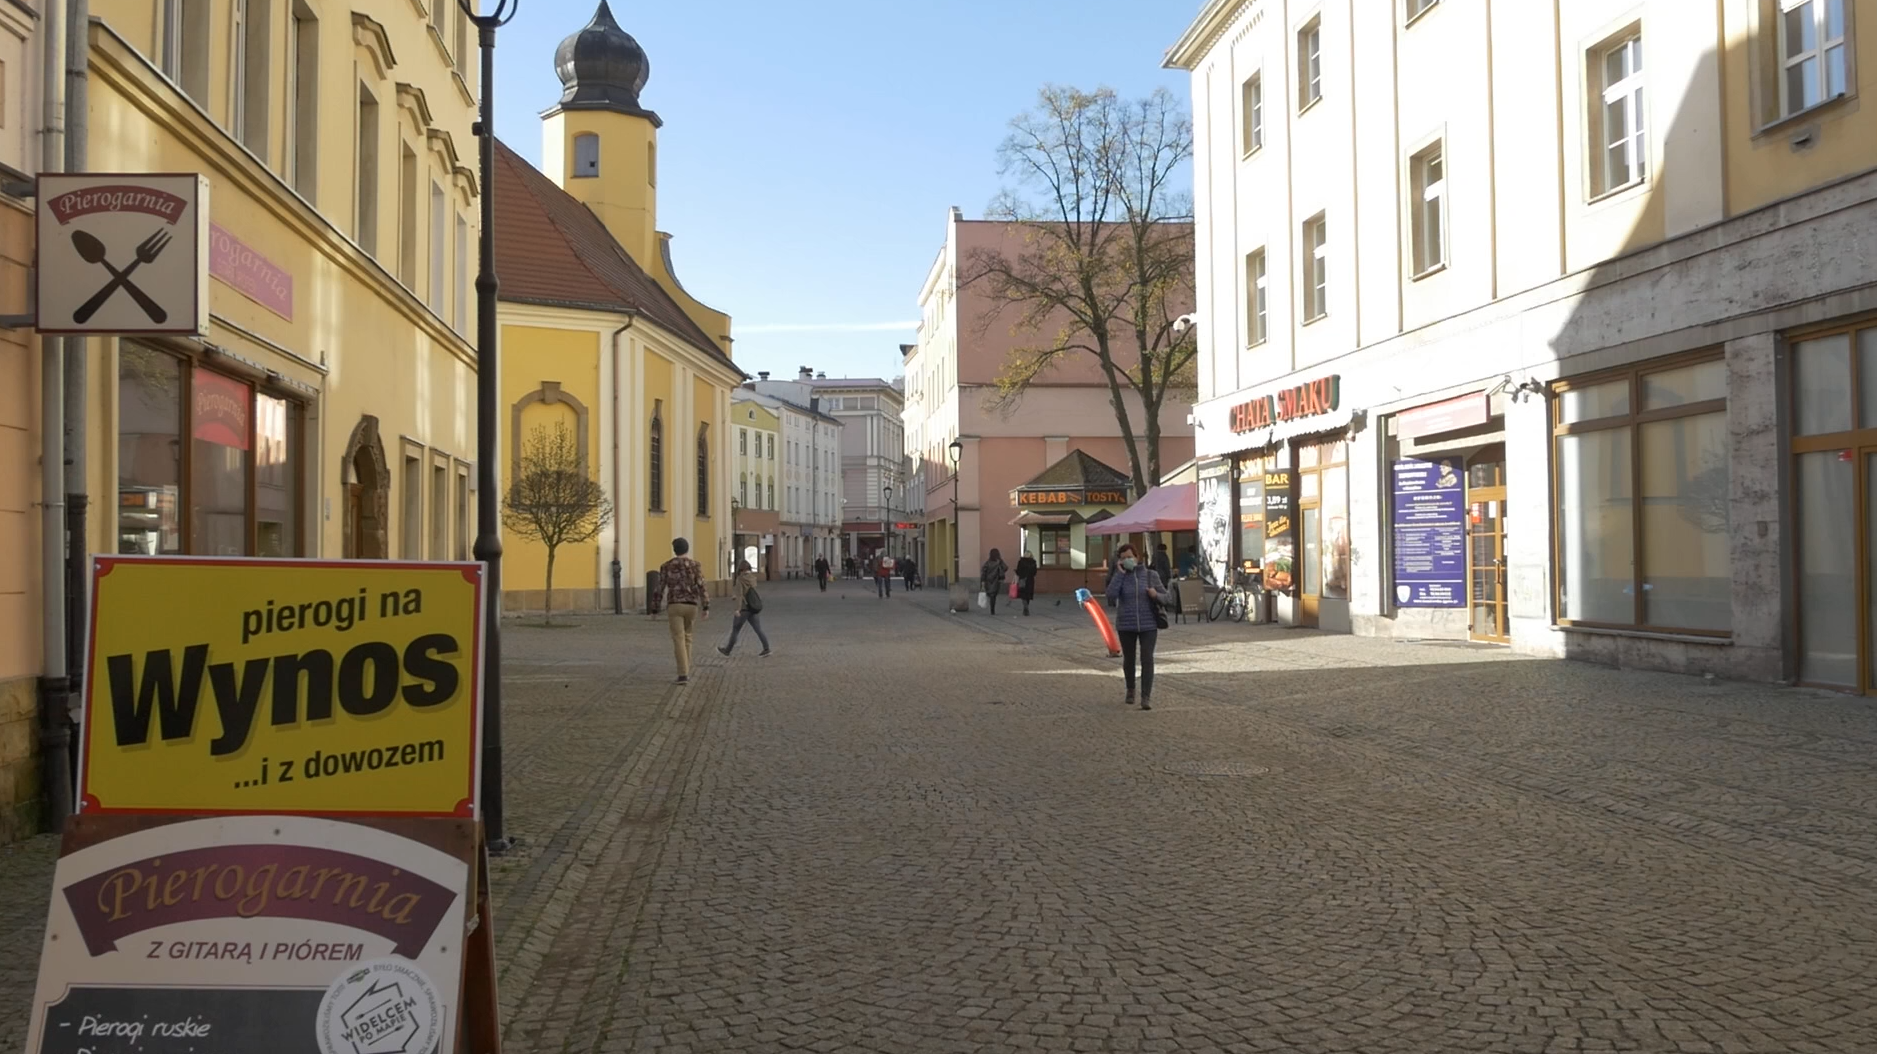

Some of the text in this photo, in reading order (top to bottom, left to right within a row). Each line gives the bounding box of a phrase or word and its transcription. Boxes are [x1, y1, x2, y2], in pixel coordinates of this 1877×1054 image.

[60, 191, 175, 214] Pierogarnia
[210, 230, 287, 300] rogarnia
[1276, 375, 1340, 422] SMAKU
[1265, 474, 1289, 484] BAR
[1020, 492, 1119, 504] KEBAB TOSTY
[242, 588, 422, 644] pierogi na
[107, 633, 460, 757] Wynos
[278, 760, 294, 783] z
[304, 739, 444, 779] dowozem
[98, 858, 422, 926] Pierogarnia
[146, 939, 364, 964] Z GITARĄ I PIÓREM
[373, 964, 393, 972] BYŁO
[151, 1016, 211, 1038] ruskie
[341, 996, 417, 1042] WIDELCEM
[359, 1014, 406, 1043] PO MAPIE
